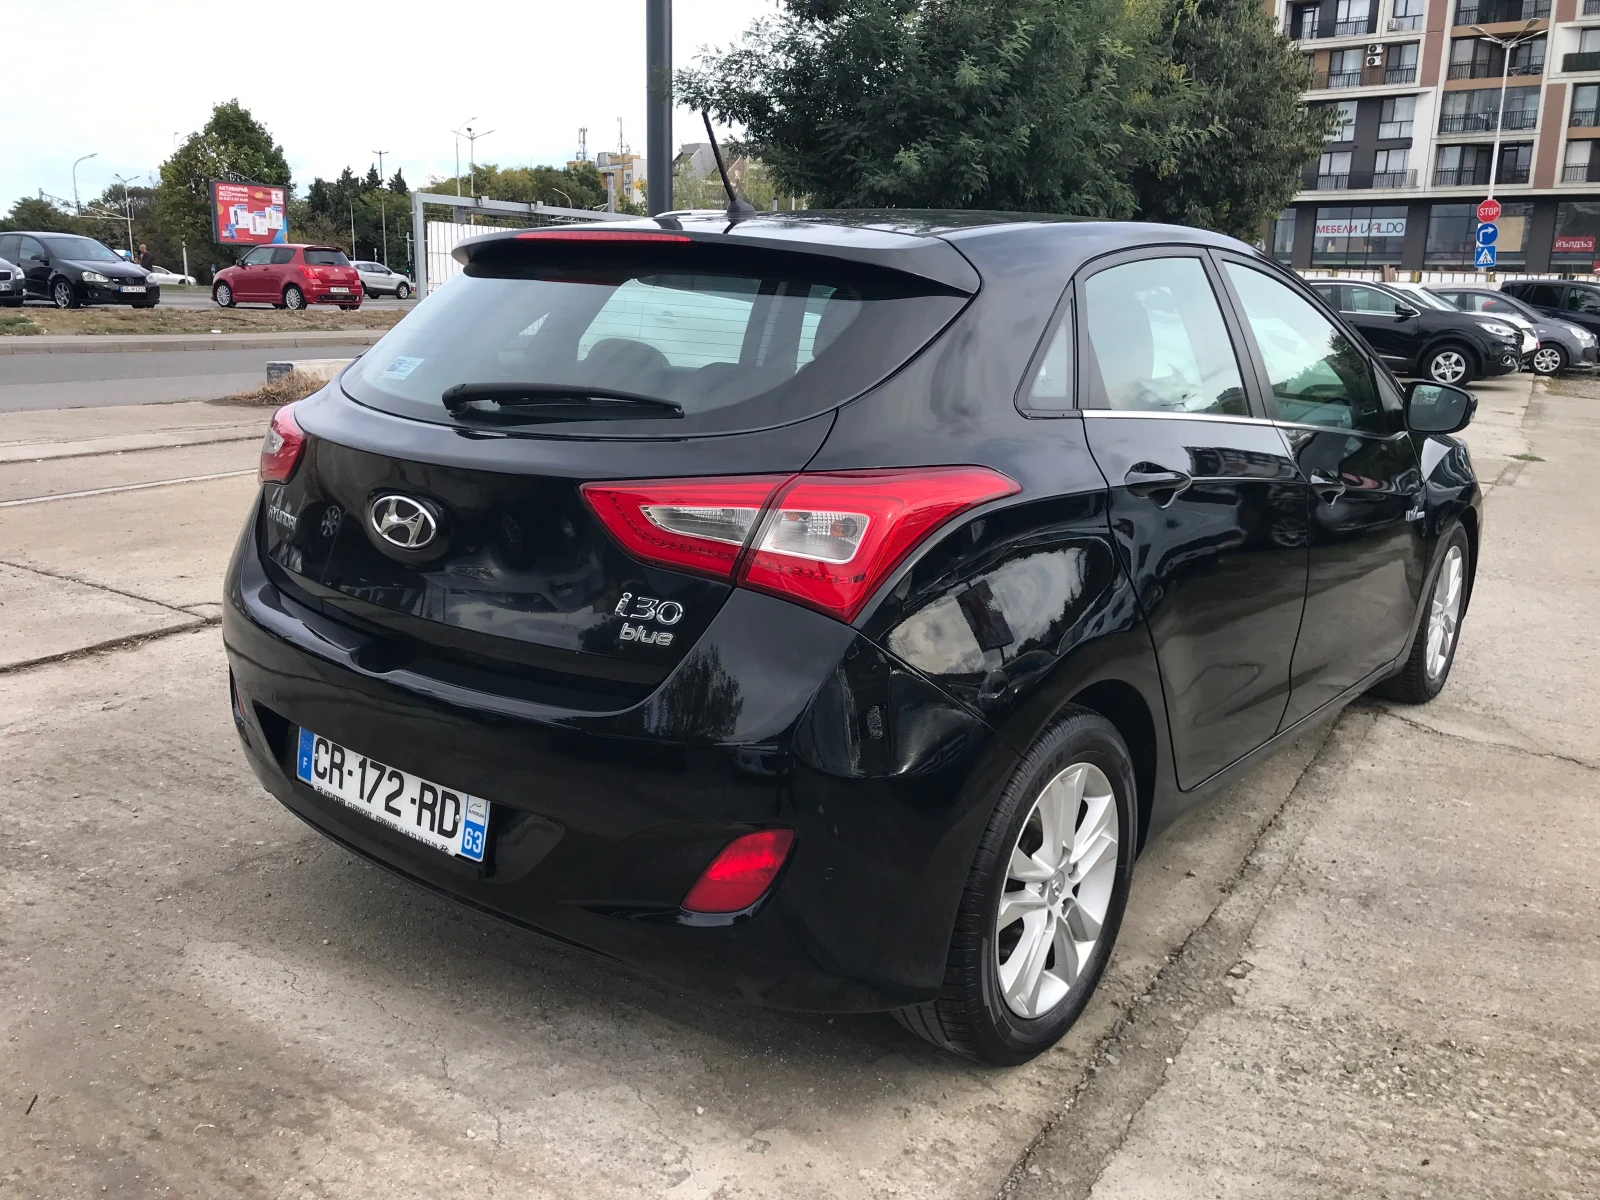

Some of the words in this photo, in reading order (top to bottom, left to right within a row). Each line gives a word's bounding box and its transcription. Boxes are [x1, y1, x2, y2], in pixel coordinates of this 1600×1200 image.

[1479, 207, 1499, 216] STOP
[1316, 224, 1358, 234] МЕБЕЛИ
[1555, 239, 1593, 249] ЙЪЛДЪЗ
[614, 592, 684, 626] i30
[619, 622, 674, 647] blue
[302, 756, 309, 769] F
[313, 737, 462, 839] CR-172-RD
[463, 827, 484, 854] 63
